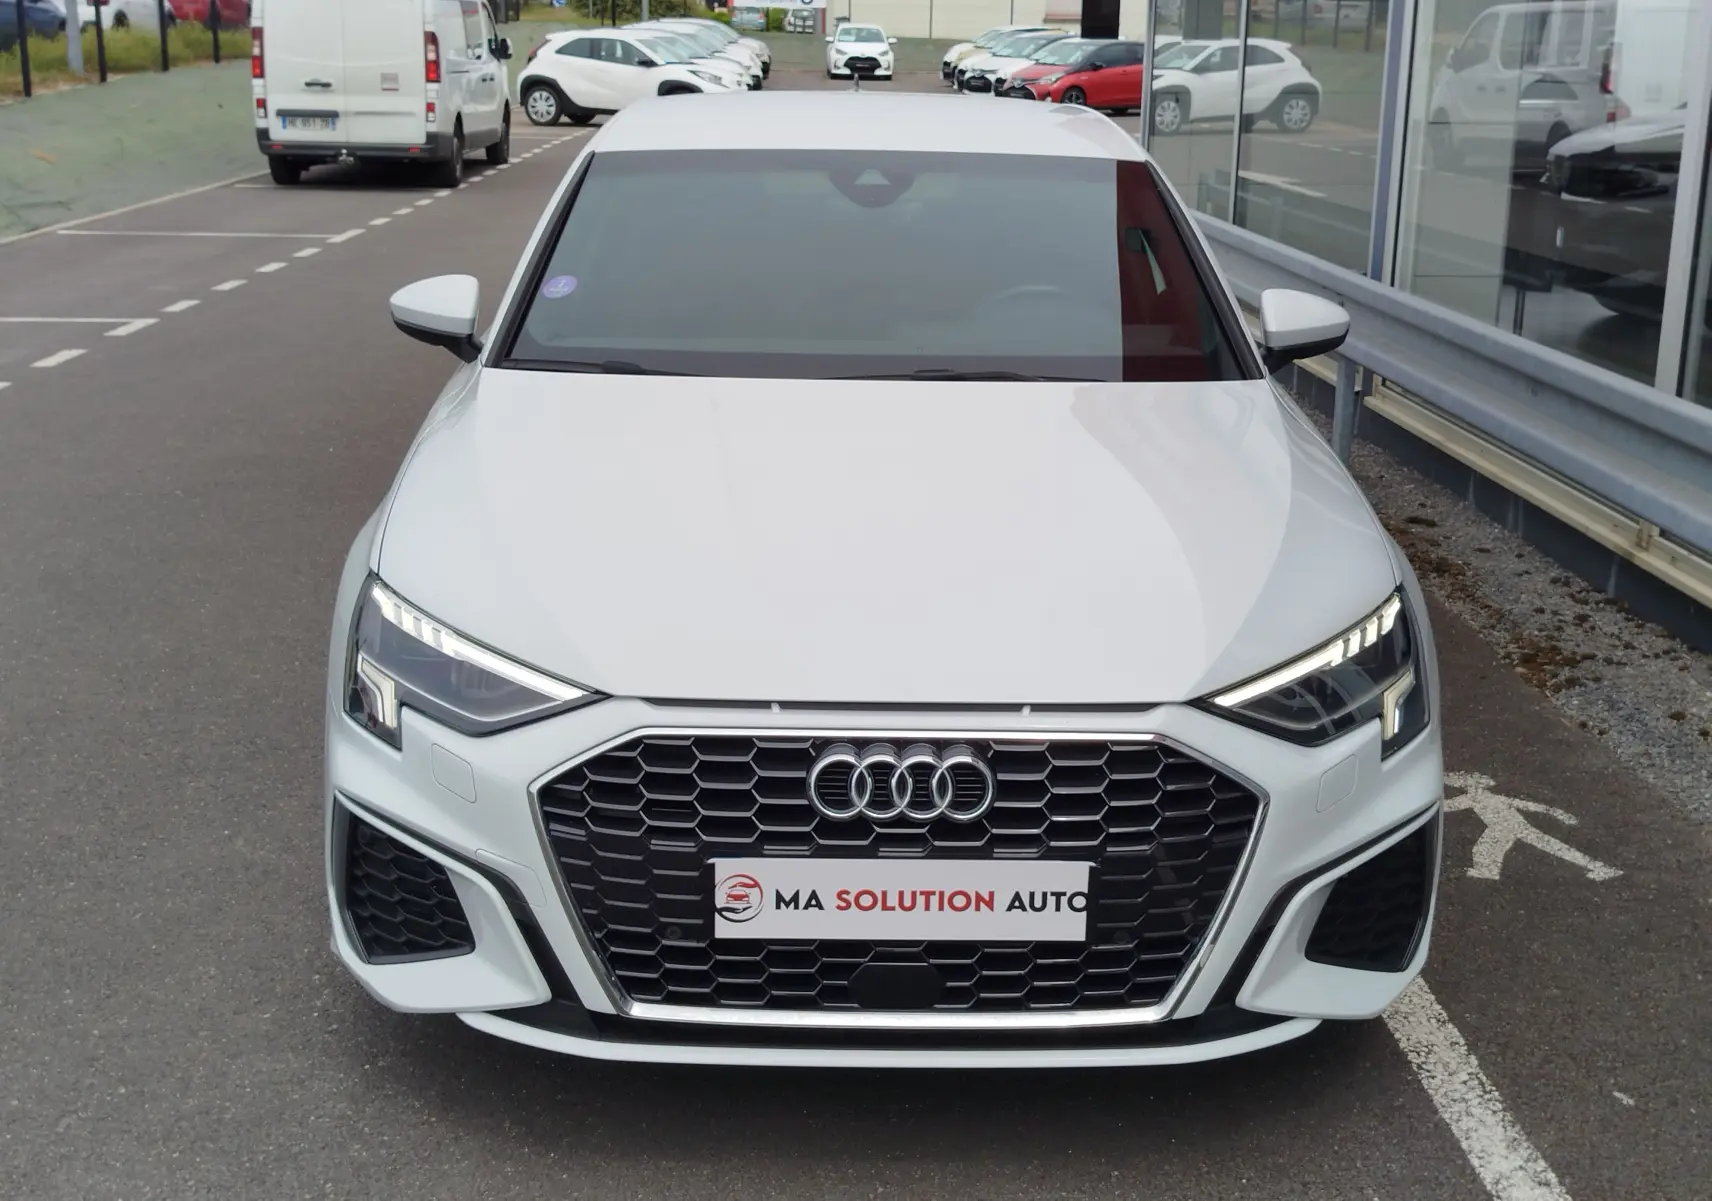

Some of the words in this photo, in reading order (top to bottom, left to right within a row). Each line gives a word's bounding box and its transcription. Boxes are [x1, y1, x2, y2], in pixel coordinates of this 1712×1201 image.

[775, 889, 825, 911] MA
[835, 889, 995, 912] SOLUTION
[1006, 891, 1089, 913] AUTO
